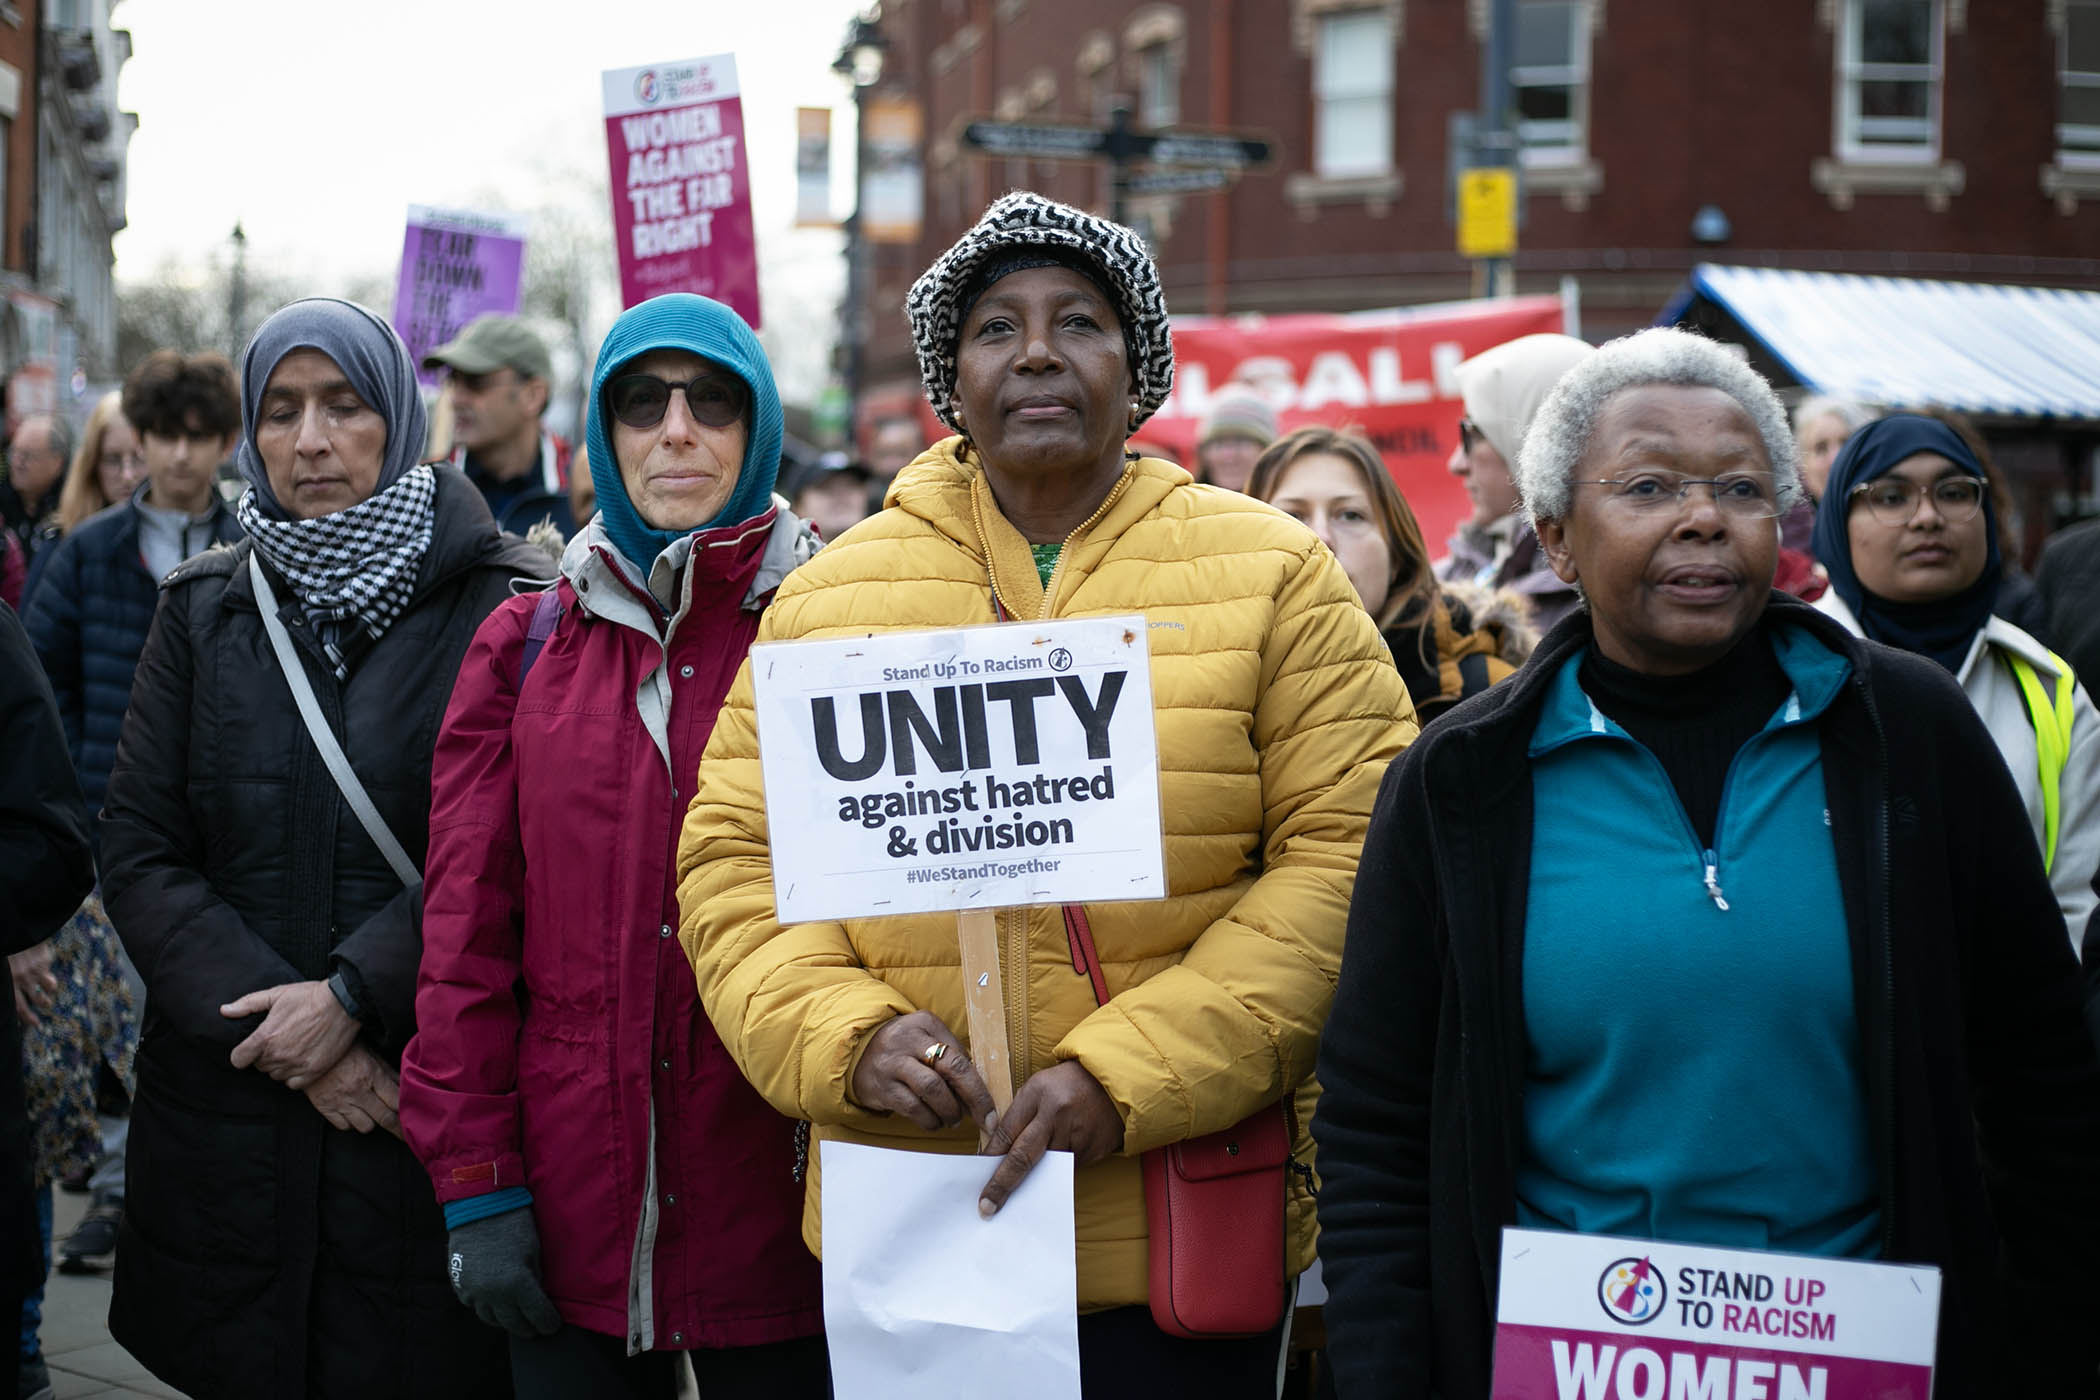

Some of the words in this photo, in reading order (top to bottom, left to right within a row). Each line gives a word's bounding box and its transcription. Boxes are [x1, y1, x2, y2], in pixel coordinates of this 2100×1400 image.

[621, 104, 722, 152] WOMEN
[627, 135, 737, 188] AGAINST
[627, 183, 684, 221] THE
[687, 172, 735, 213] FAR
[631, 211, 714, 260] RIGHT
[1147, 621, 1185, 631] OPPERS
[883, 664, 929, 681] Stand
[934, 662, 956, 680] Up
[960, 660, 980, 675] To
[984, 655, 1043, 673] Racism
[811, 671, 1128, 781] UNITY
[838, 780, 979, 829] against
[986, 765, 1115, 809] hatred
[887, 825, 918, 857] &
[925, 811, 1074, 855] division
[907, 858, 1061, 884] #WeStandTogether
[1678, 1267, 1774, 1302] STAND
[1784, 1277, 1826, 1307] UP
[1677, 1299, 1714, 1329] TO
[1723, 1303, 1837, 1342] RACISM
